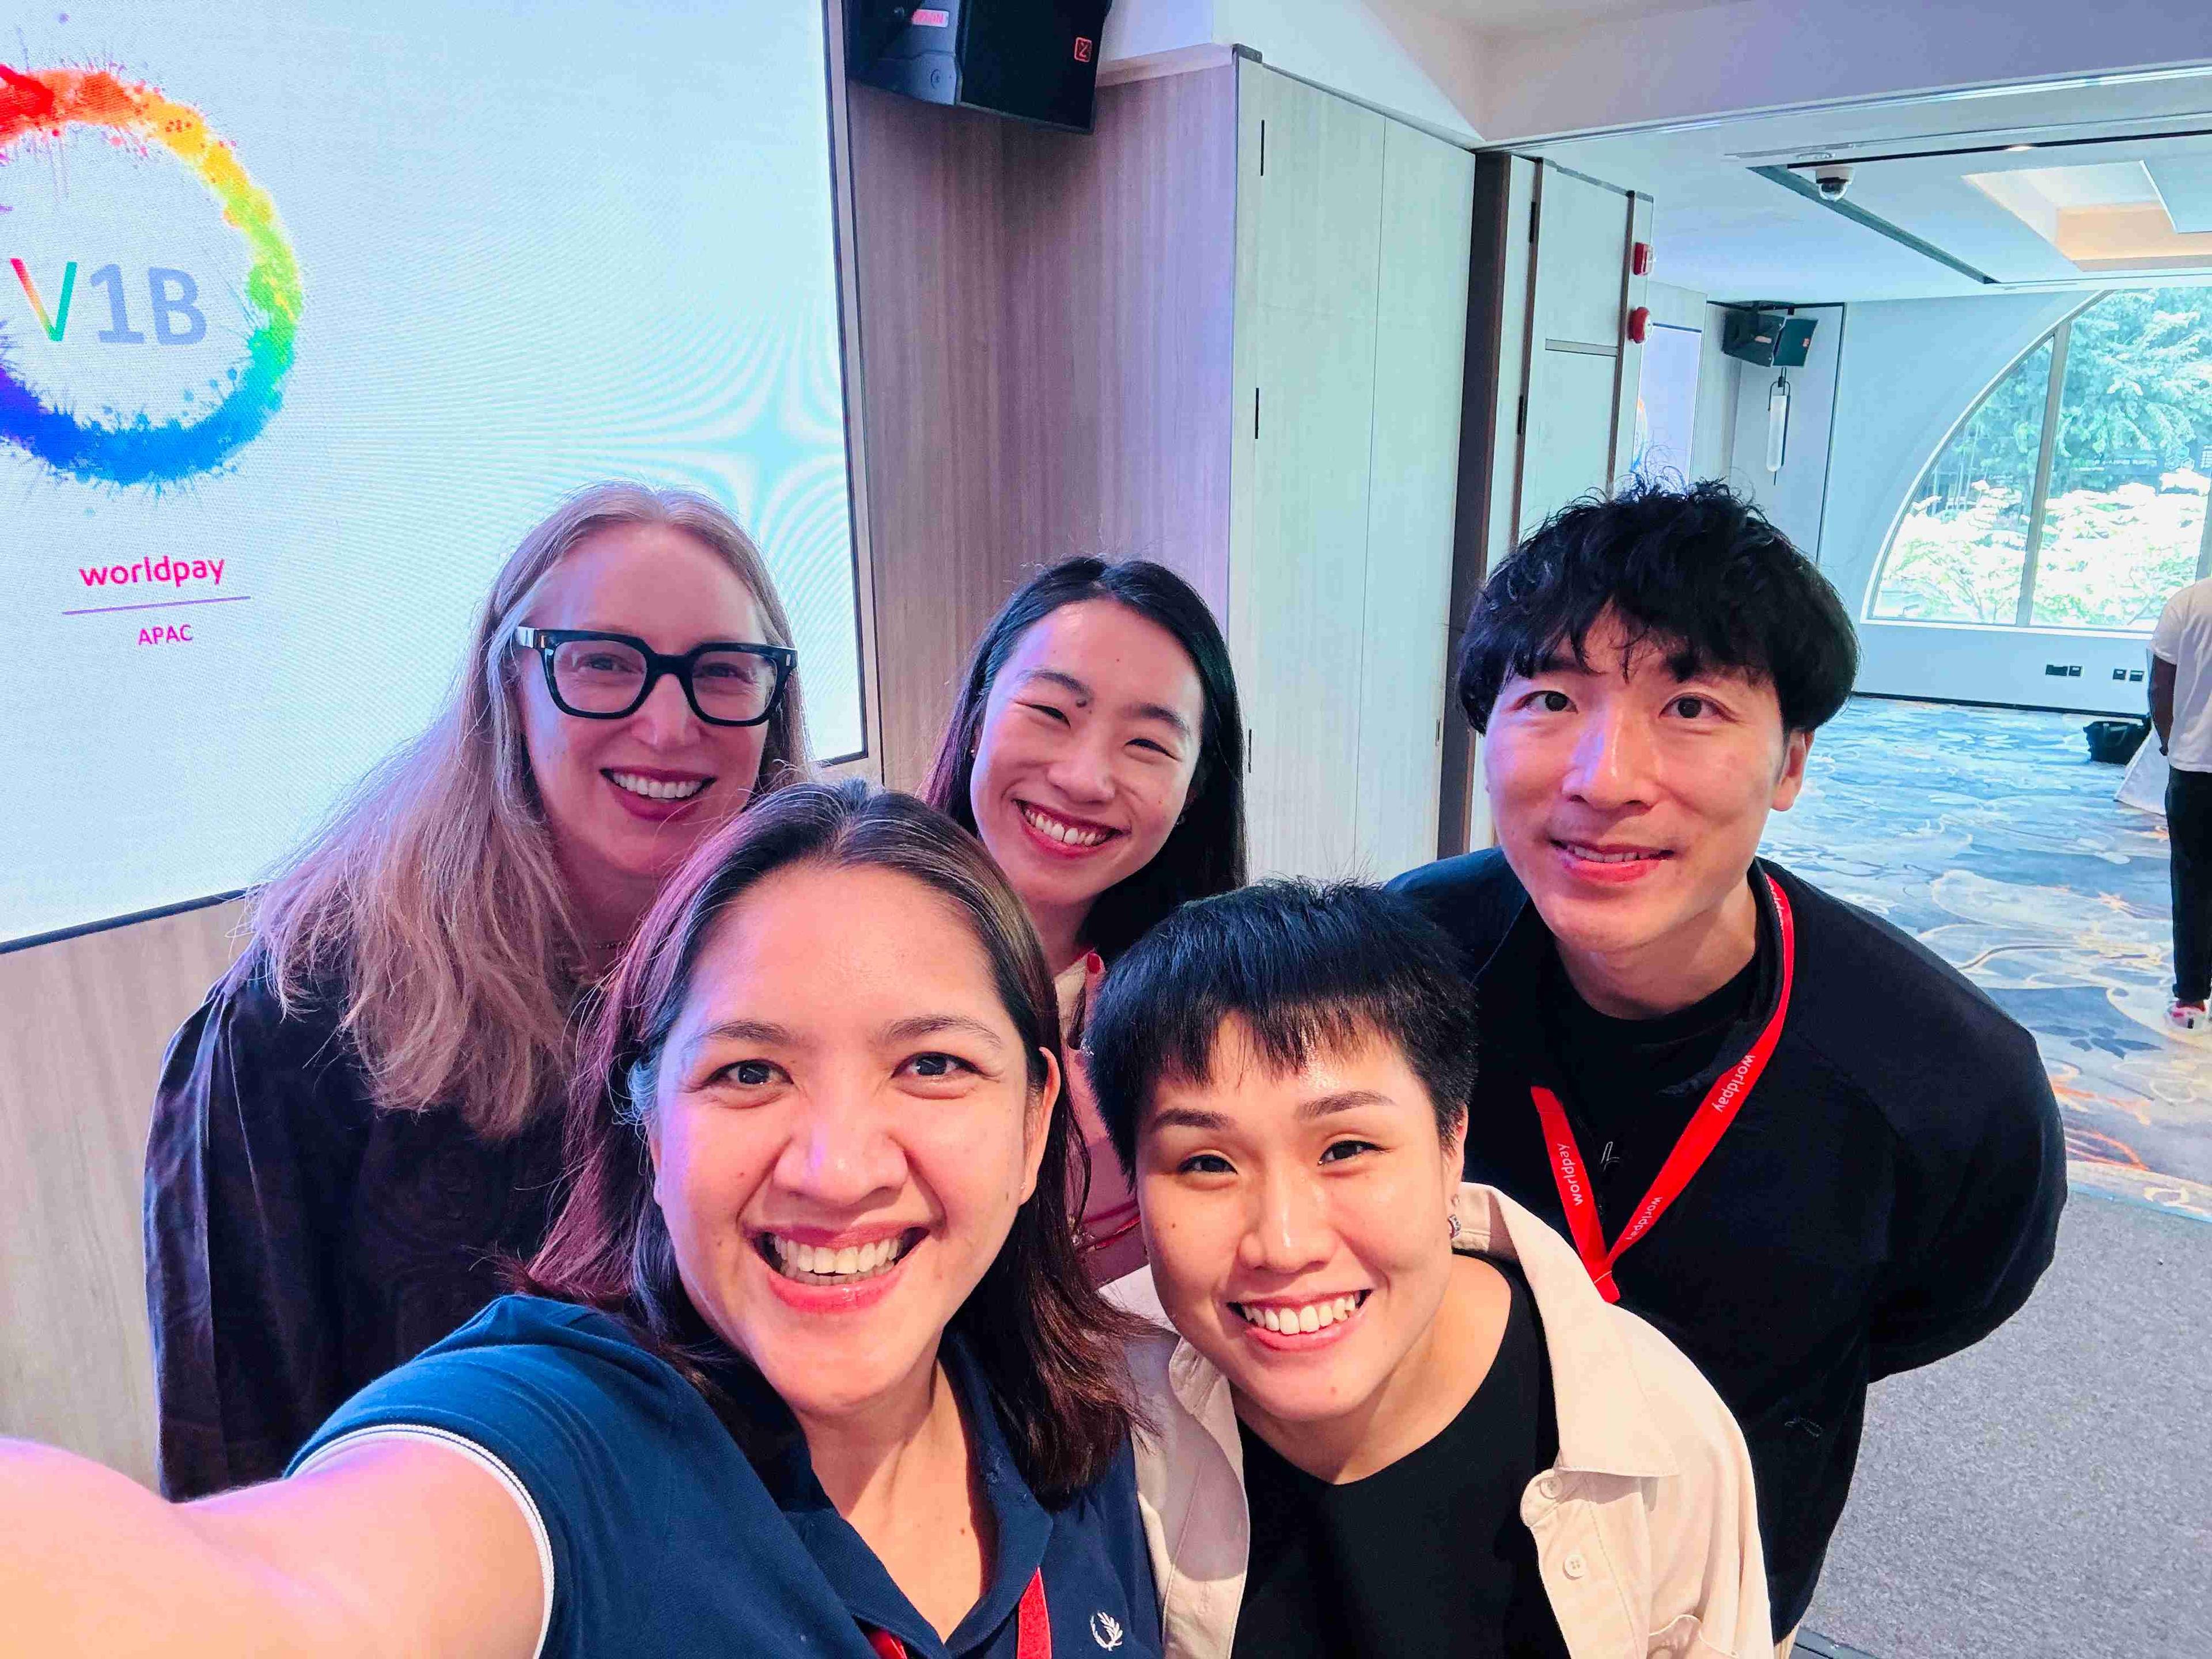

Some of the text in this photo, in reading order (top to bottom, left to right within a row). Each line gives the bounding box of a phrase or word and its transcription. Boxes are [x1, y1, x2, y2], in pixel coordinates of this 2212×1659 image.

[10, 257, 206, 345] V1B
[79, 555, 225, 587] worldpay
[138, 624, 194, 645] APAC
[1711, 1055, 1756, 1112] worldpay
[1556, 1143, 1584, 1206] worldpay
